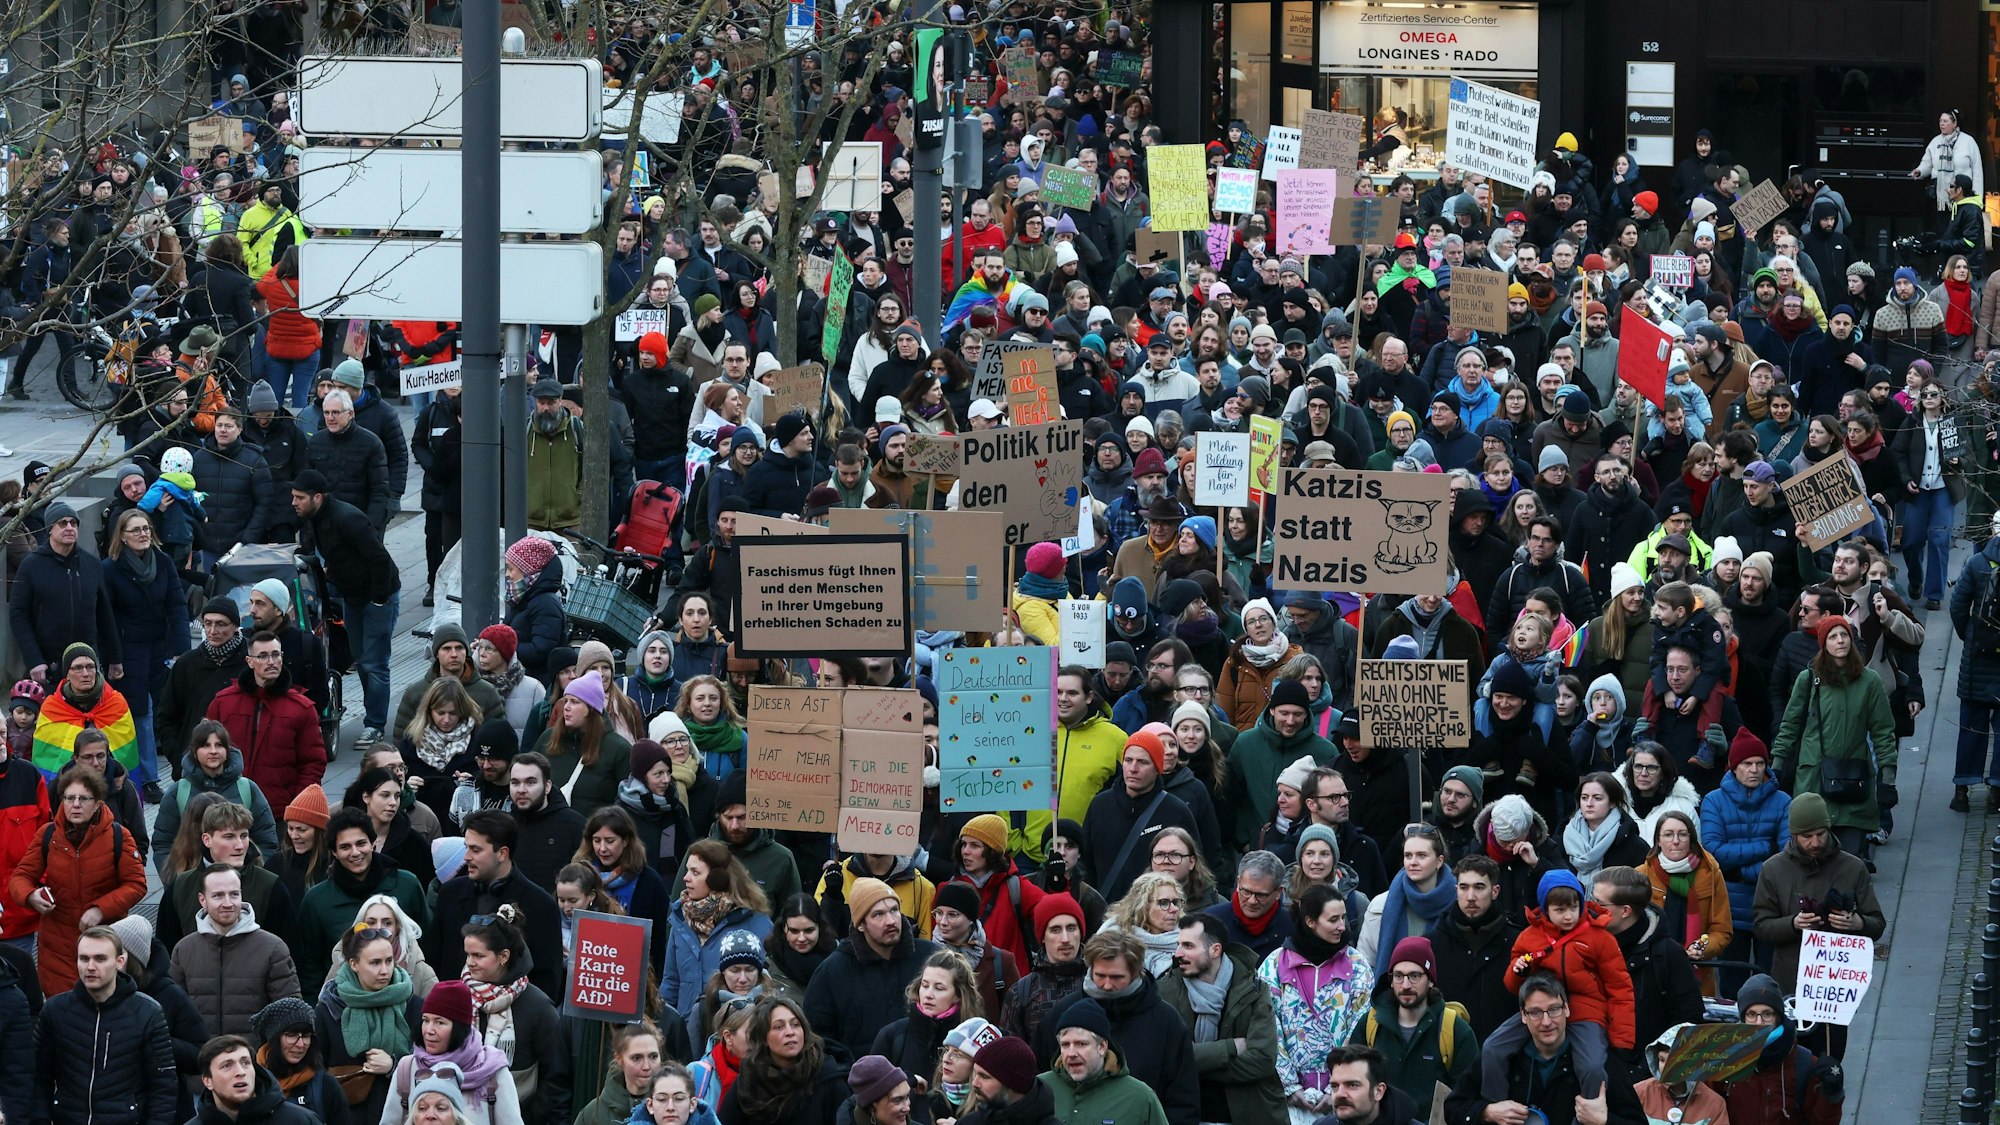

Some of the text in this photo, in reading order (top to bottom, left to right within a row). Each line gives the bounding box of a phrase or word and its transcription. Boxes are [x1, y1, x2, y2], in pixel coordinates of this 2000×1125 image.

[1360, 13, 1498, 24] Zertifiziertes Service-Center
[1399, 32, 1458, 43] OMEGA
[1642, 42, 1660, 52] 52
[1358, 48, 1498, 62] LONGINES RADO
[1306, 113, 1339, 126] FRITZE
[1456, 120, 1468, 132] und
[1304, 125, 1335, 138] FISCHT
[1303, 137, 1349, 152] FASCHOS
[1178, 146, 1204, 158] RECHTE
[1301, 149, 1328, 160] FRISCHE
[1464, 138, 1476, 150] der
[1508, 150, 1528, 168] Kacke
[1176, 158, 1196, 168] ALLE
[1176, 169, 1200, 180] NICHT
[1222, 171, 1240, 180] WITH
[1502, 168, 1530, 185] müssen
[1182, 180, 1207, 192] RECHTE
[1220, 183, 1252, 196] DEMO
[1284, 178, 1303, 188] Jetzt
[1152, 202, 1166, 212] DAS
[1168, 200, 1181, 210] IST
[1672, 258, 1690, 270] BLEIBT
[1654, 272, 1690, 285] BUNT
[1466, 284, 1486, 296] NERVEN
[1470, 300, 1481, 310] HAT
[1482, 302, 1494, 313] NUR
[619, 310, 665, 322] NIE WIEDER
[1452, 312, 1495, 328] GROSSES MAUL
[620, 322, 662, 334] IST JETZT
[964, 424, 1080, 465] Politik für
[1252, 430, 1272, 446] BUNT
[1942, 436, 1960, 450] MERZ
[1208, 440, 1238, 452] Mehr
[1206, 453, 1244, 471] Bildung
[1218, 467, 1234, 482] für
[1208, 478, 1237, 496] Nazis!
[1284, 469, 1382, 500] Katzis
[1785, 458, 1853, 506] NAZIS HASSEN
[962, 482, 1007, 508] den
[1793, 477, 1860, 524] DIESEN TRICK
[1280, 515, 1352, 540] statt
[1814, 504, 1860, 541] BILDUNG
[1065, 537, 1080, 551] CDU
[748, 565, 896, 578] Faschismus fügt Ihnen
[1278, 554, 1368, 584] Nazis
[760, 582, 884, 594] und den Menschen
[762, 600, 883, 612] in Ihrer Umgebung
[1072, 603, 1090, 611] 5 VOR
[744, 617, 902, 628] erheblichen Schaden zu
[1073, 612, 1088, 620] 1933
[951, 663, 1033, 690] Deutschland
[1361, 662, 1465, 682] RECHTS IST WIE
[1360, 684, 1446, 705] WLAN OHNE
[752, 694, 830, 712] DIESER AST
[995, 710, 1022, 723] von
[974, 731, 1015, 747] seinen
[1374, 736, 1446, 748] UNSICHER
[758, 747, 830, 766] HAT MEHR
[889, 762, 909, 774] DIE
[750, 768, 830, 784] MENSCHLICHKEIT
[850, 779, 913, 797] DEMOKRATIE
[951, 771, 1018, 798] Farben
[751, 796, 792, 809] ALS DIE
[848, 796, 911, 808] GETAN ALS
[750, 810, 825, 824] GESAMTE AfD
[884, 823, 892, 835] &
[896, 824, 915, 837] CO.
[1804, 932, 1866, 950] NIE WIEDER
[581, 940, 618, 958] Rote
[1816, 949, 1850, 963] MUSS
[580, 957, 625, 976] Karte
[1804, 964, 1868, 984] NIE WIEDER
[578, 972, 630, 992] für die
[576, 990, 612, 1006] AfD!
[1803, 984, 1857, 1002] BLEIBEN
